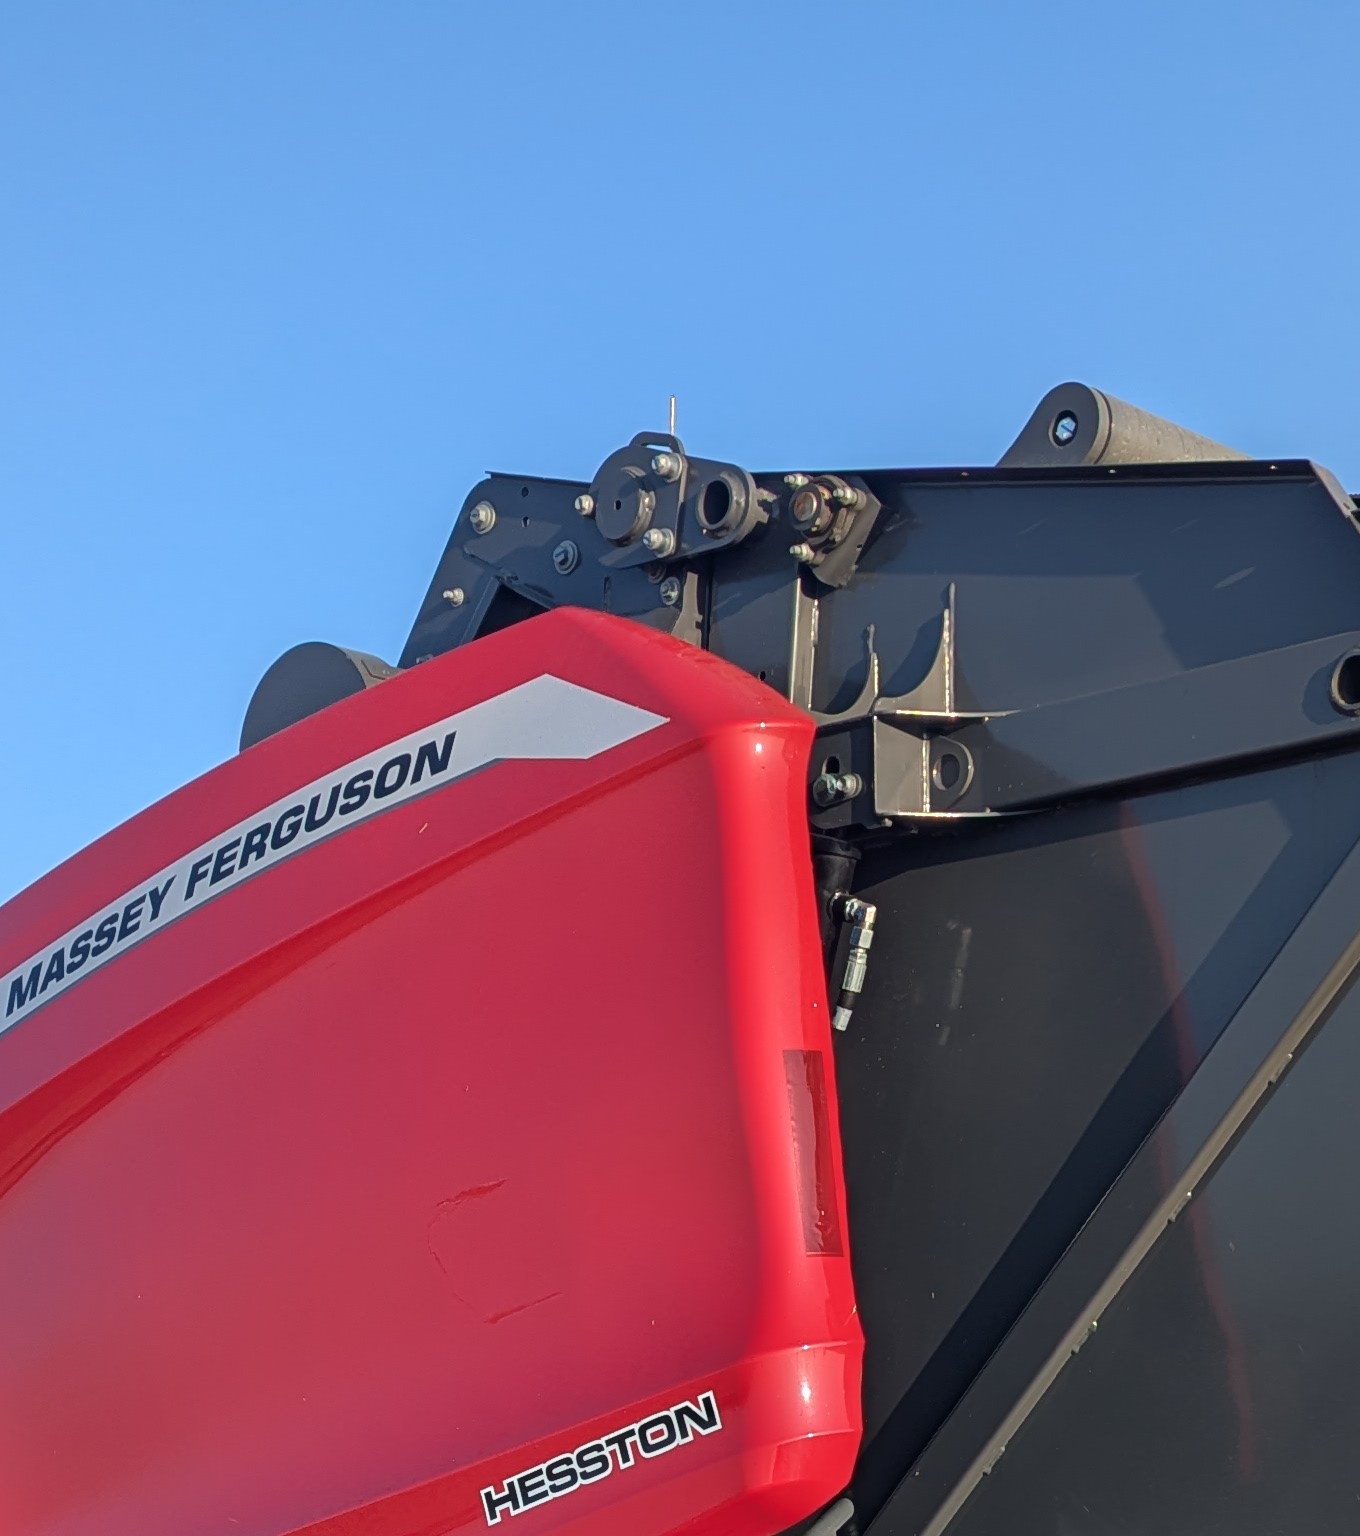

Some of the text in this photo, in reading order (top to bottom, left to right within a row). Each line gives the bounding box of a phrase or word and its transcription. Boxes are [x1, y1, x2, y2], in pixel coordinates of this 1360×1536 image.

[5, 730, 457, 1018] MASSEY FERGUSON
[482, 1391, 722, 1526] HESSTON
